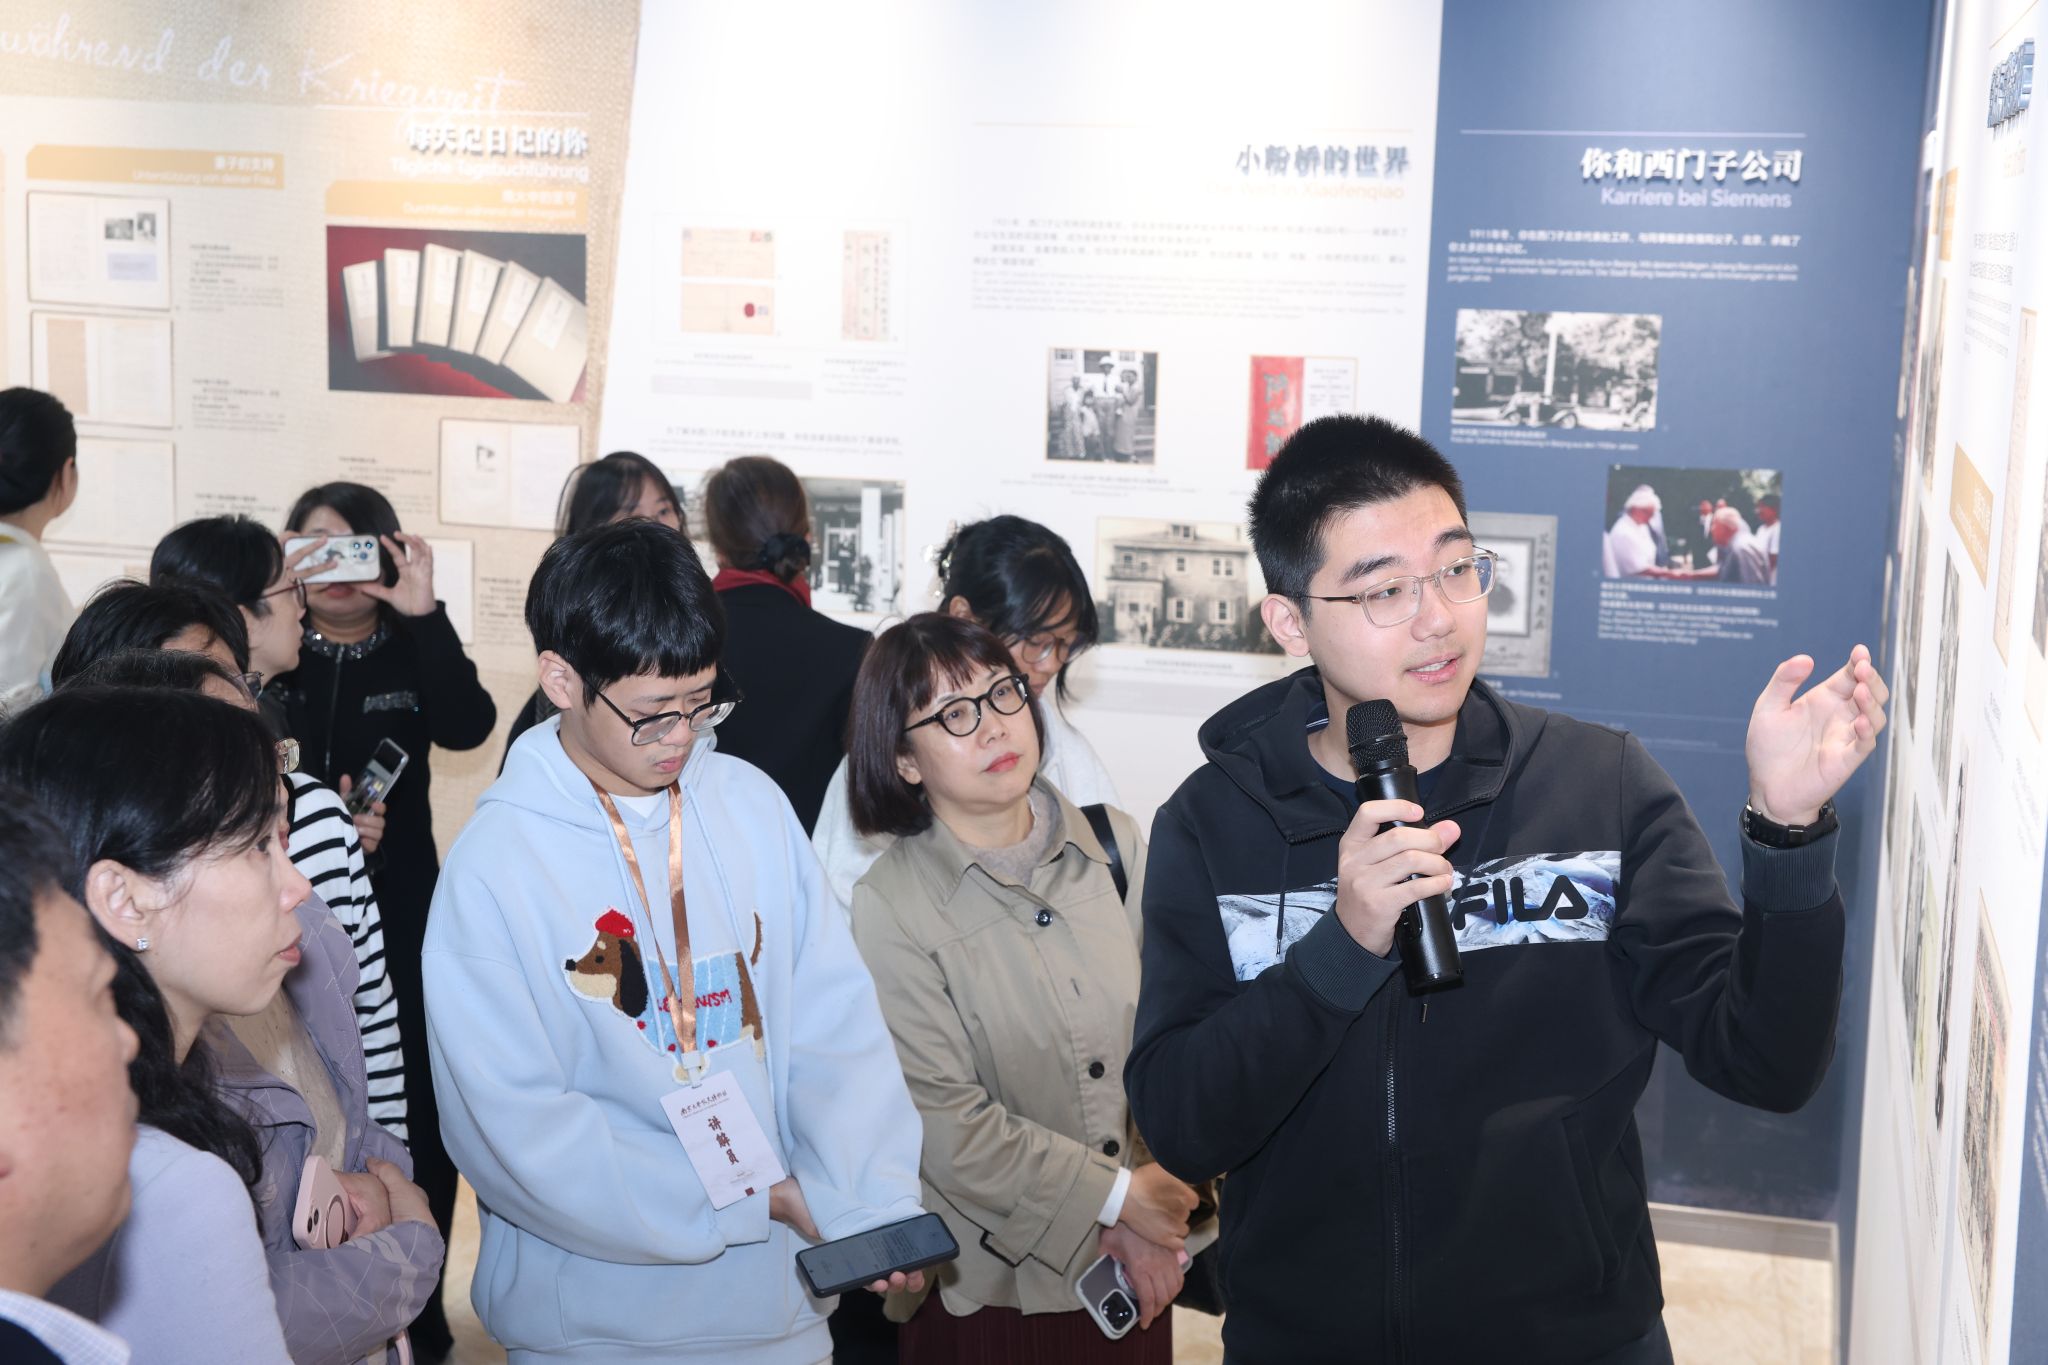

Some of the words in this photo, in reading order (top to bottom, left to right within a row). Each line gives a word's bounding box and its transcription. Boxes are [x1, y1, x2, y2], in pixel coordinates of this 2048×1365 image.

[1580, 147, 1803, 183] 你和西门子公司
[1601, 187, 1674, 206] Karriere
[1678, 188, 1707, 206] bei
[1711, 189, 1792, 208] Siemens
[1452, 874, 1590, 931] FILA
[707, 1115, 740, 1166] 讲解员
